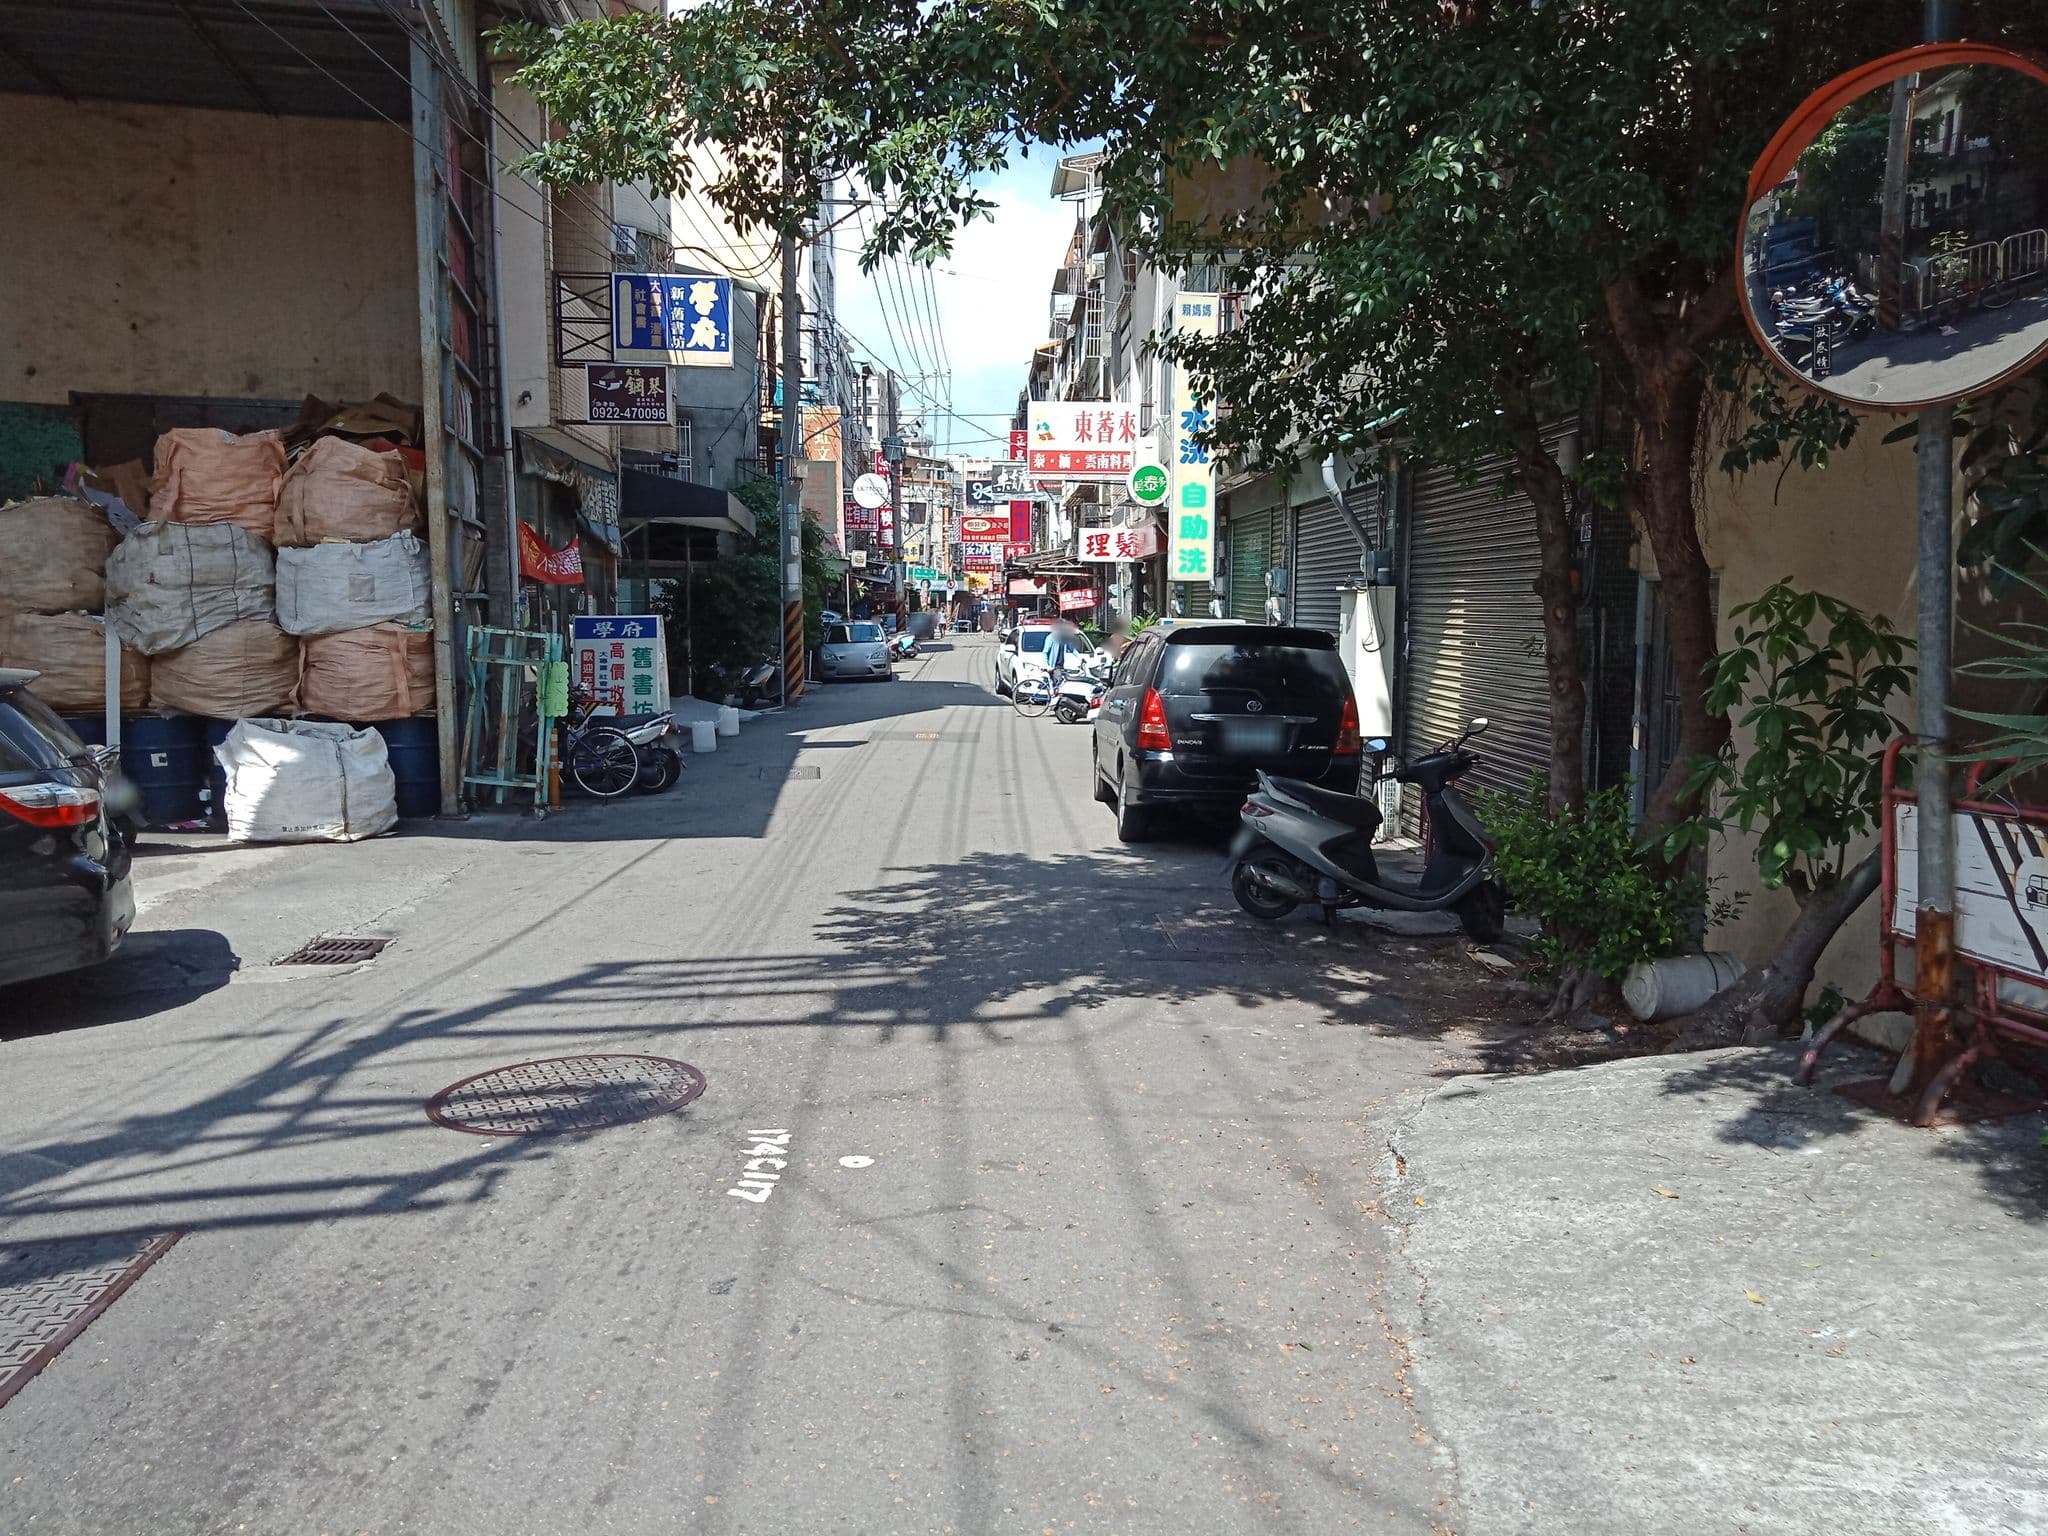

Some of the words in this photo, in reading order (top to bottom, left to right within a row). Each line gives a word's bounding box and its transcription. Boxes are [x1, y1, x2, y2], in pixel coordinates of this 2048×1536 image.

[624, 376, 664, 397] 鋼琴
[592, 407, 666, 419] 0922-470096
[1179, 483, 1208, 574] 自助洗
[1086, 532, 1138, 558] 理髮
[592, 621, 643, 638] 學府
[632, 647, 653, 714] 舊書坊
